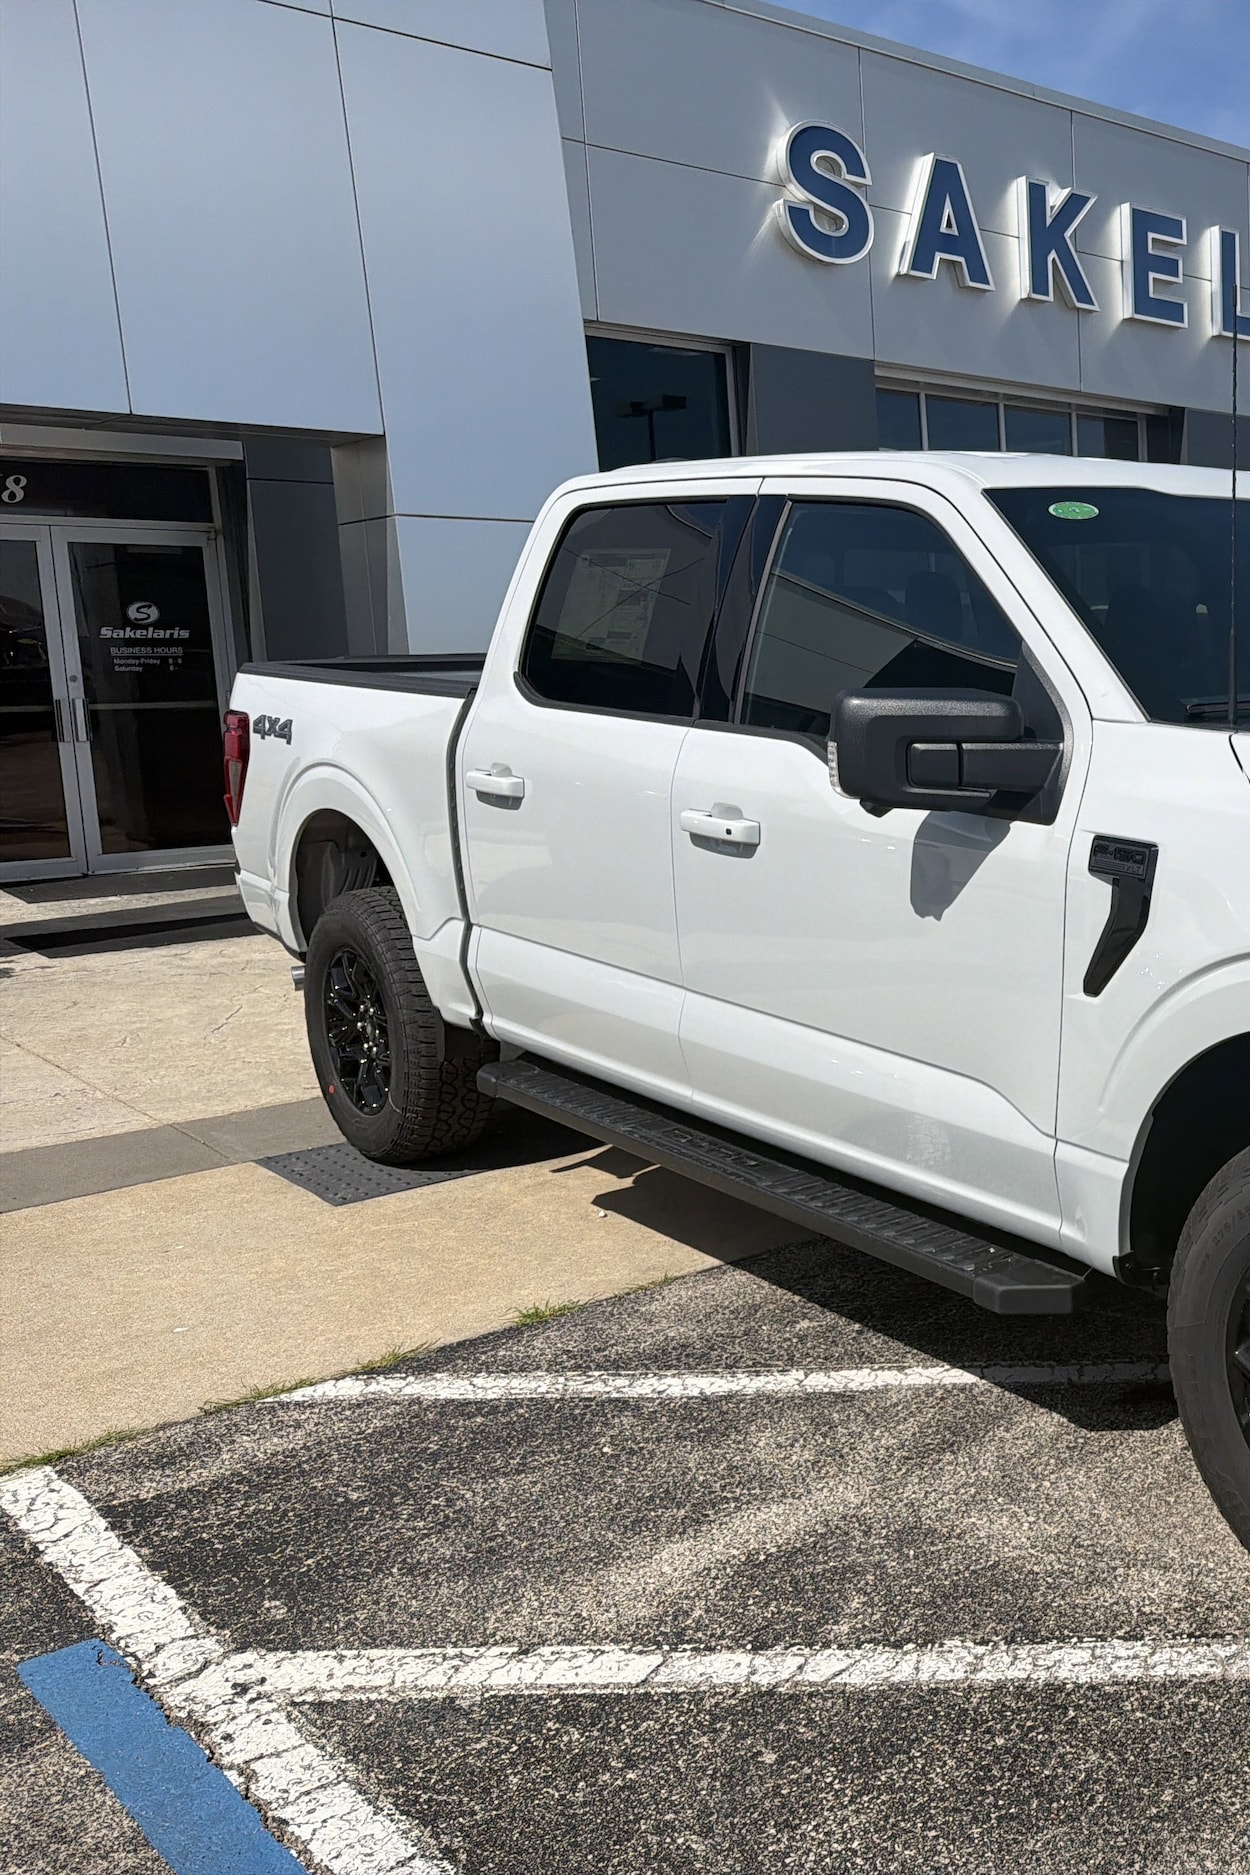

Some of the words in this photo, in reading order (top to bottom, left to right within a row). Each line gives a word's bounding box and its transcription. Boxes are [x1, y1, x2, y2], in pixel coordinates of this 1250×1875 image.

[100, 627, 190, 639] Sakelaris
[110, 646, 152, 654] BUSINESS
[153, 646, 183, 654] HOURS
[1126, 864, 1142, 875] XLT
